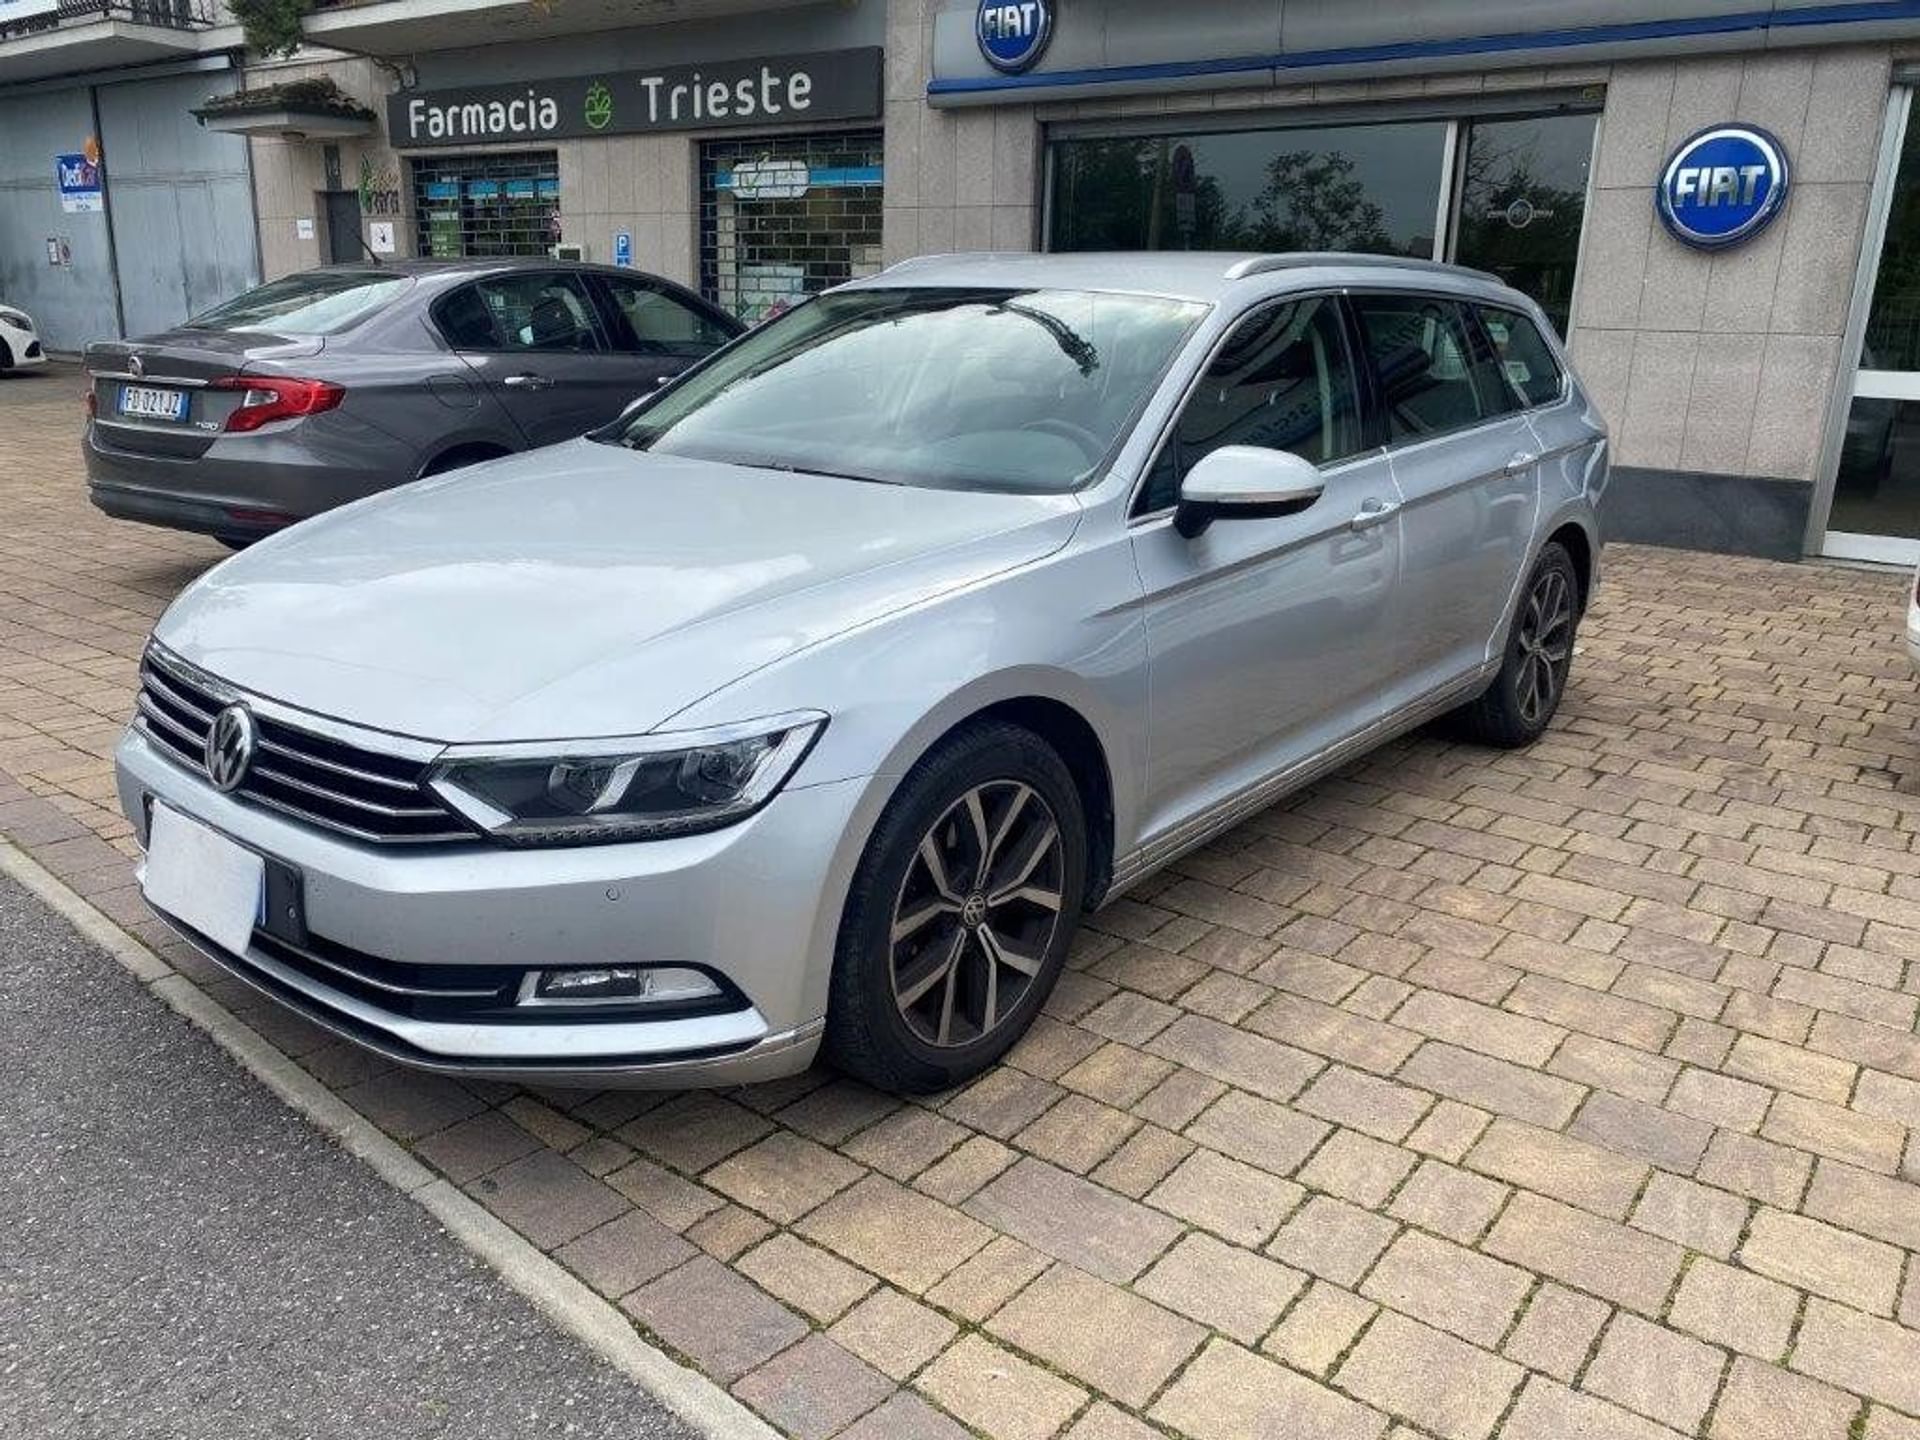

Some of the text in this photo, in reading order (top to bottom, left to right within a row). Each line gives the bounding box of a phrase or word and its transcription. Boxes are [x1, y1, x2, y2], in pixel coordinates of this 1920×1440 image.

[984, 3, 1036, 39] FIAT
[408, 66, 812, 138] Farmacia Trieste
[1674, 164, 1766, 208] FIAT
